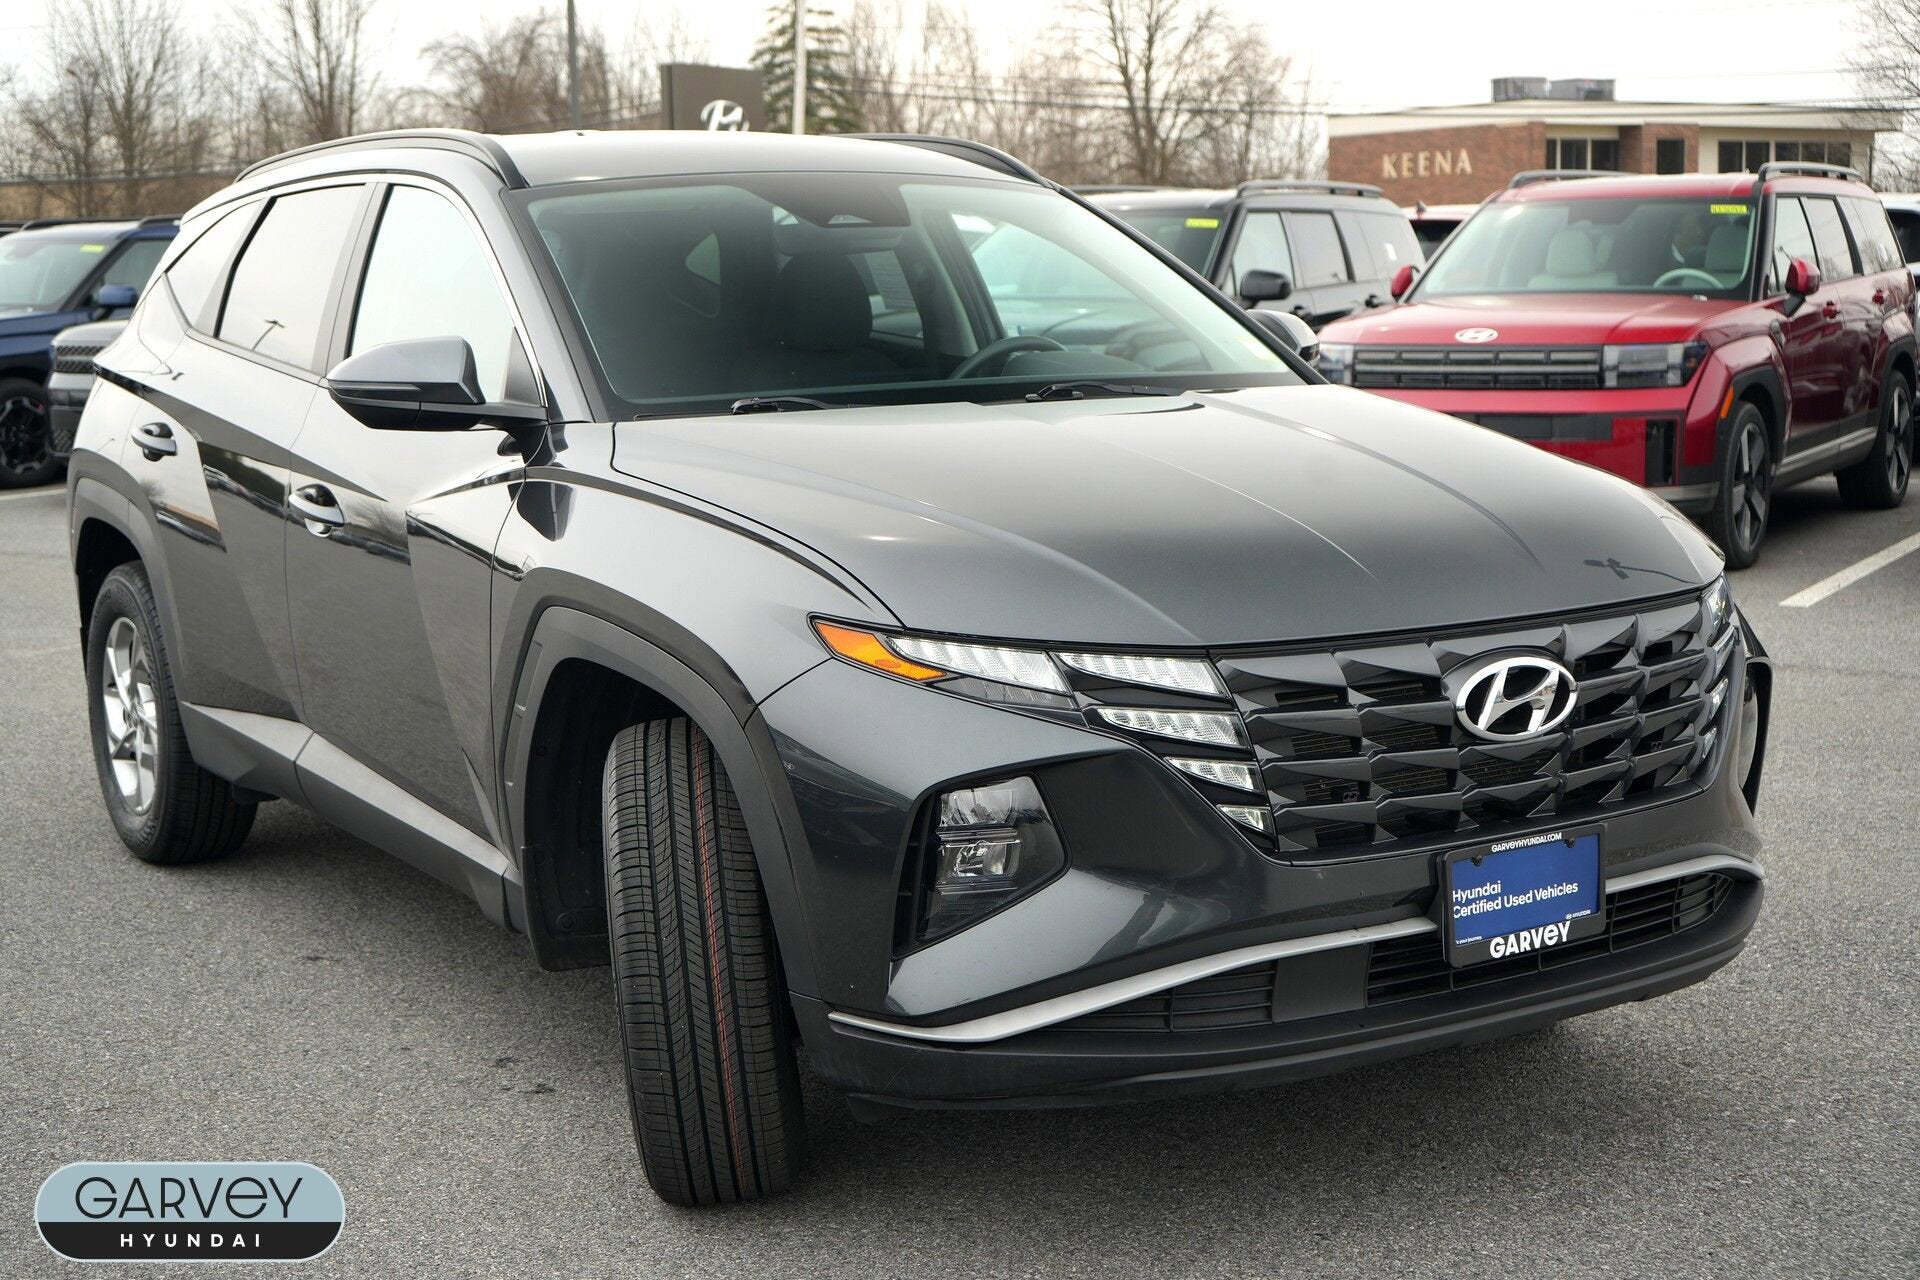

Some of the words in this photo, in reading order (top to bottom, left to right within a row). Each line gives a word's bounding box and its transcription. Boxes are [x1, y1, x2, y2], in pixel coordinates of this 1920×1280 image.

[1382, 148, 1473, 179] KEENA
[1452, 880, 1502, 904] Hyundai
[1453, 896, 1502, 919] Certified
[1504, 890, 1533, 908] Used
[1534, 882, 1578, 904] Vehicles
